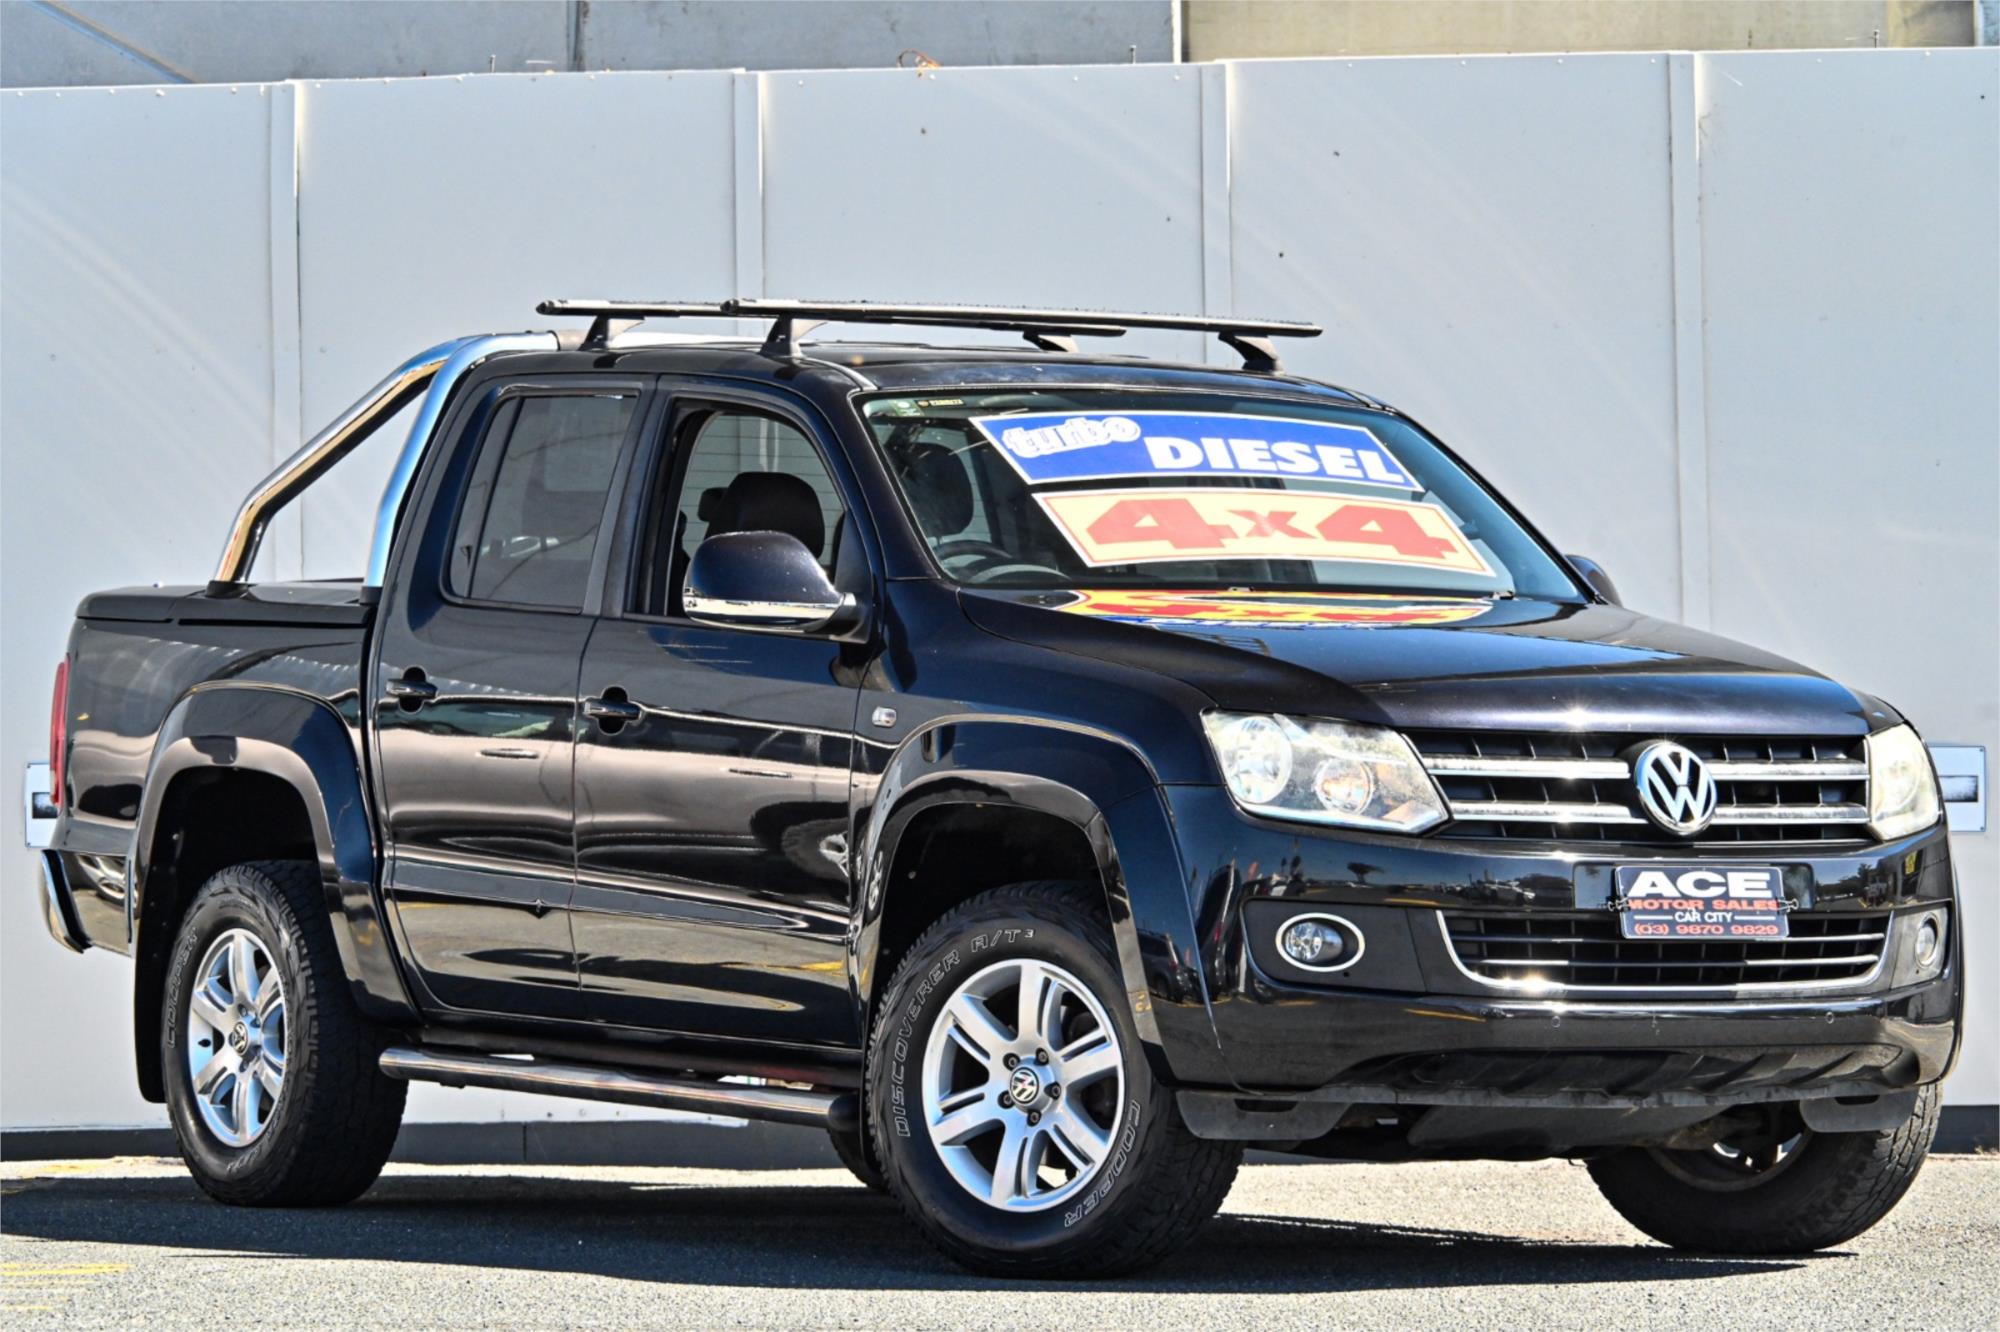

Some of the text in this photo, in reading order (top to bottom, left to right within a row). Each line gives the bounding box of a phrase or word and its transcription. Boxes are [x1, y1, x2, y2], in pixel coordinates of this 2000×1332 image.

[1002, 416, 1407, 484] turbo DIESEL
[1085, 497, 1458, 558] 4x4
[1636, 741, 1717, 834] VW
[1627, 870, 1773, 898] ACE
[1628, 899, 1779, 911] MOTOR SALES
[1634, 924, 1778, 936] (03) 9870 9829
[1675, 912, 1734, 923] CAR CITY
[892, 949, 960, 1137] DISCOVERER
[1064, 1099, 1140, 1227] COOPER
